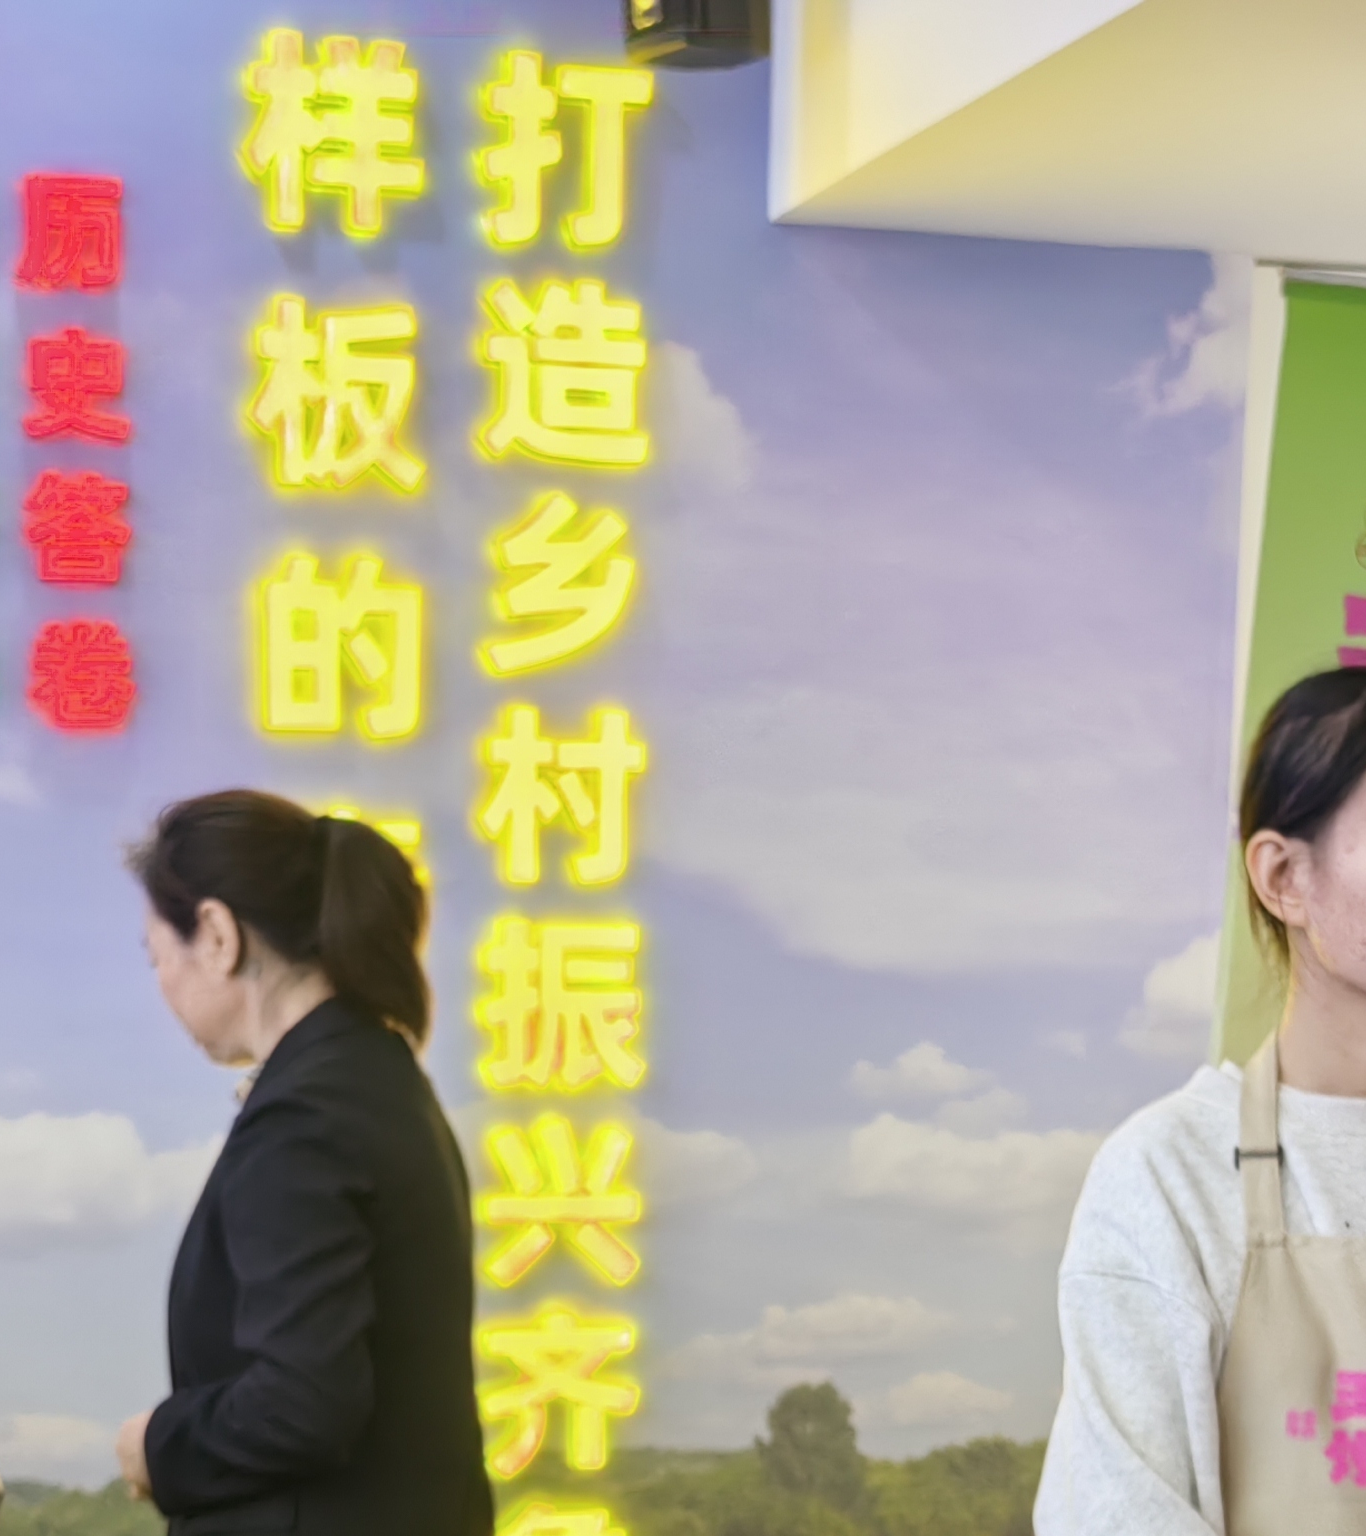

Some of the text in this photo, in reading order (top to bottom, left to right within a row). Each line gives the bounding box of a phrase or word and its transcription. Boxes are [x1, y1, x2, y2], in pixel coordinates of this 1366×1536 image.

[15, 170, 137, 730] 历史答卷
[240, 28, 427, 885] 样板的
